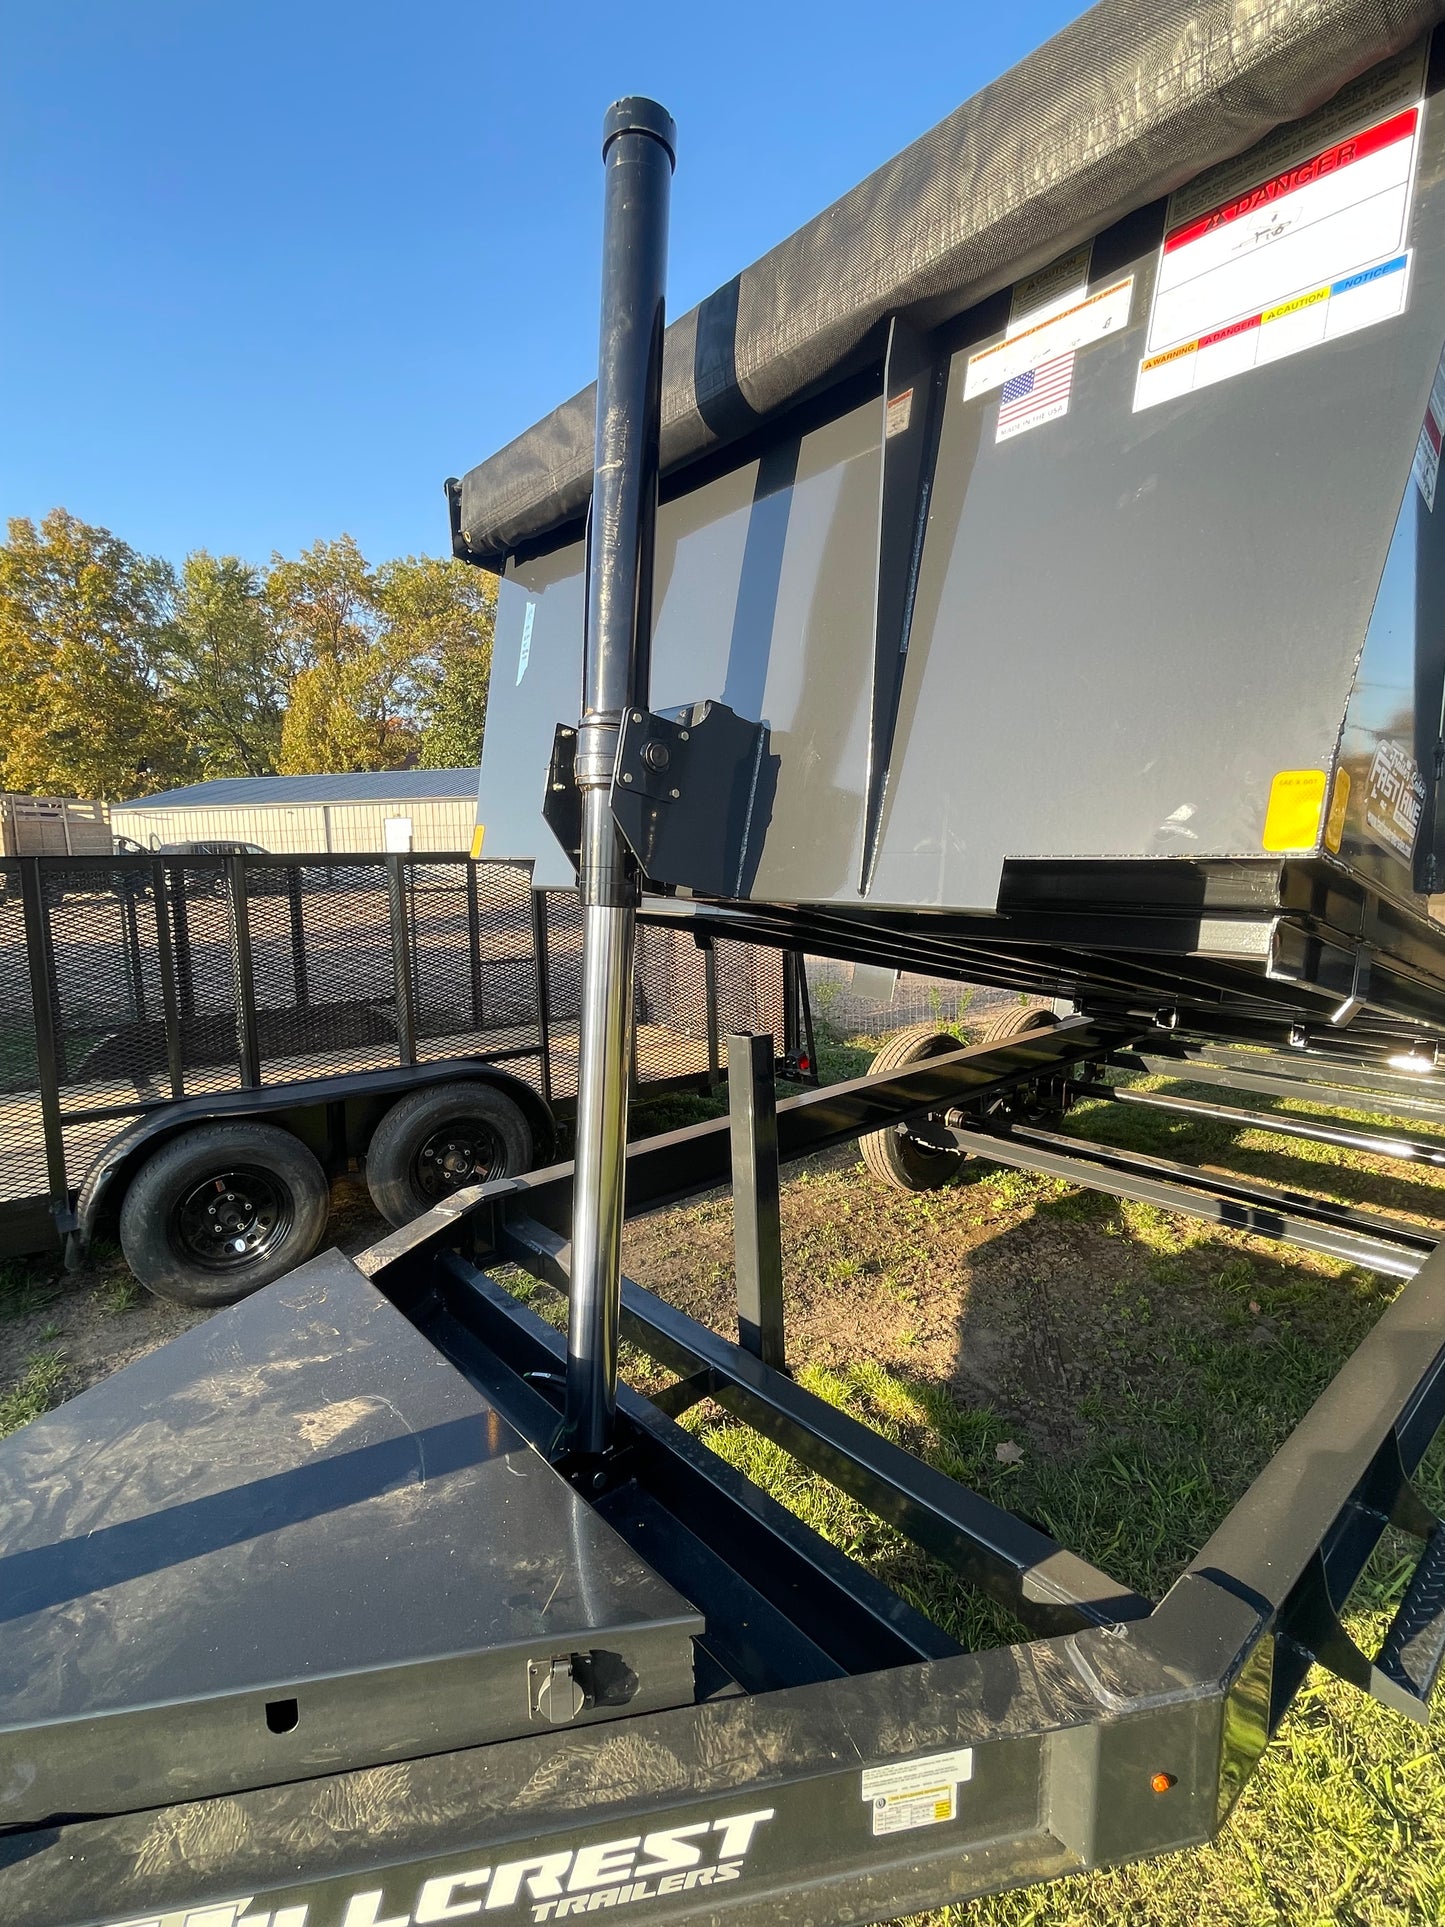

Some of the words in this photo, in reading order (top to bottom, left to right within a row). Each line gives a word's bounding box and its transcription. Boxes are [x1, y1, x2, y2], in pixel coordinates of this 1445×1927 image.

[1235, 142, 1357, 217] DANGER
[1344, 264, 1392, 289] NOTICE
[1276, 291, 1325, 316] CAUTION
[1211, 319, 1255, 344] DANGER
[1151, 343, 1195, 366] WARNING
[1048, 405, 1063, 416] USA
[1370, 751, 1401, 803] FAST
[103, 1808, 775, 1927] LCREST
[531, 1860, 744, 1923] TRAILERS
